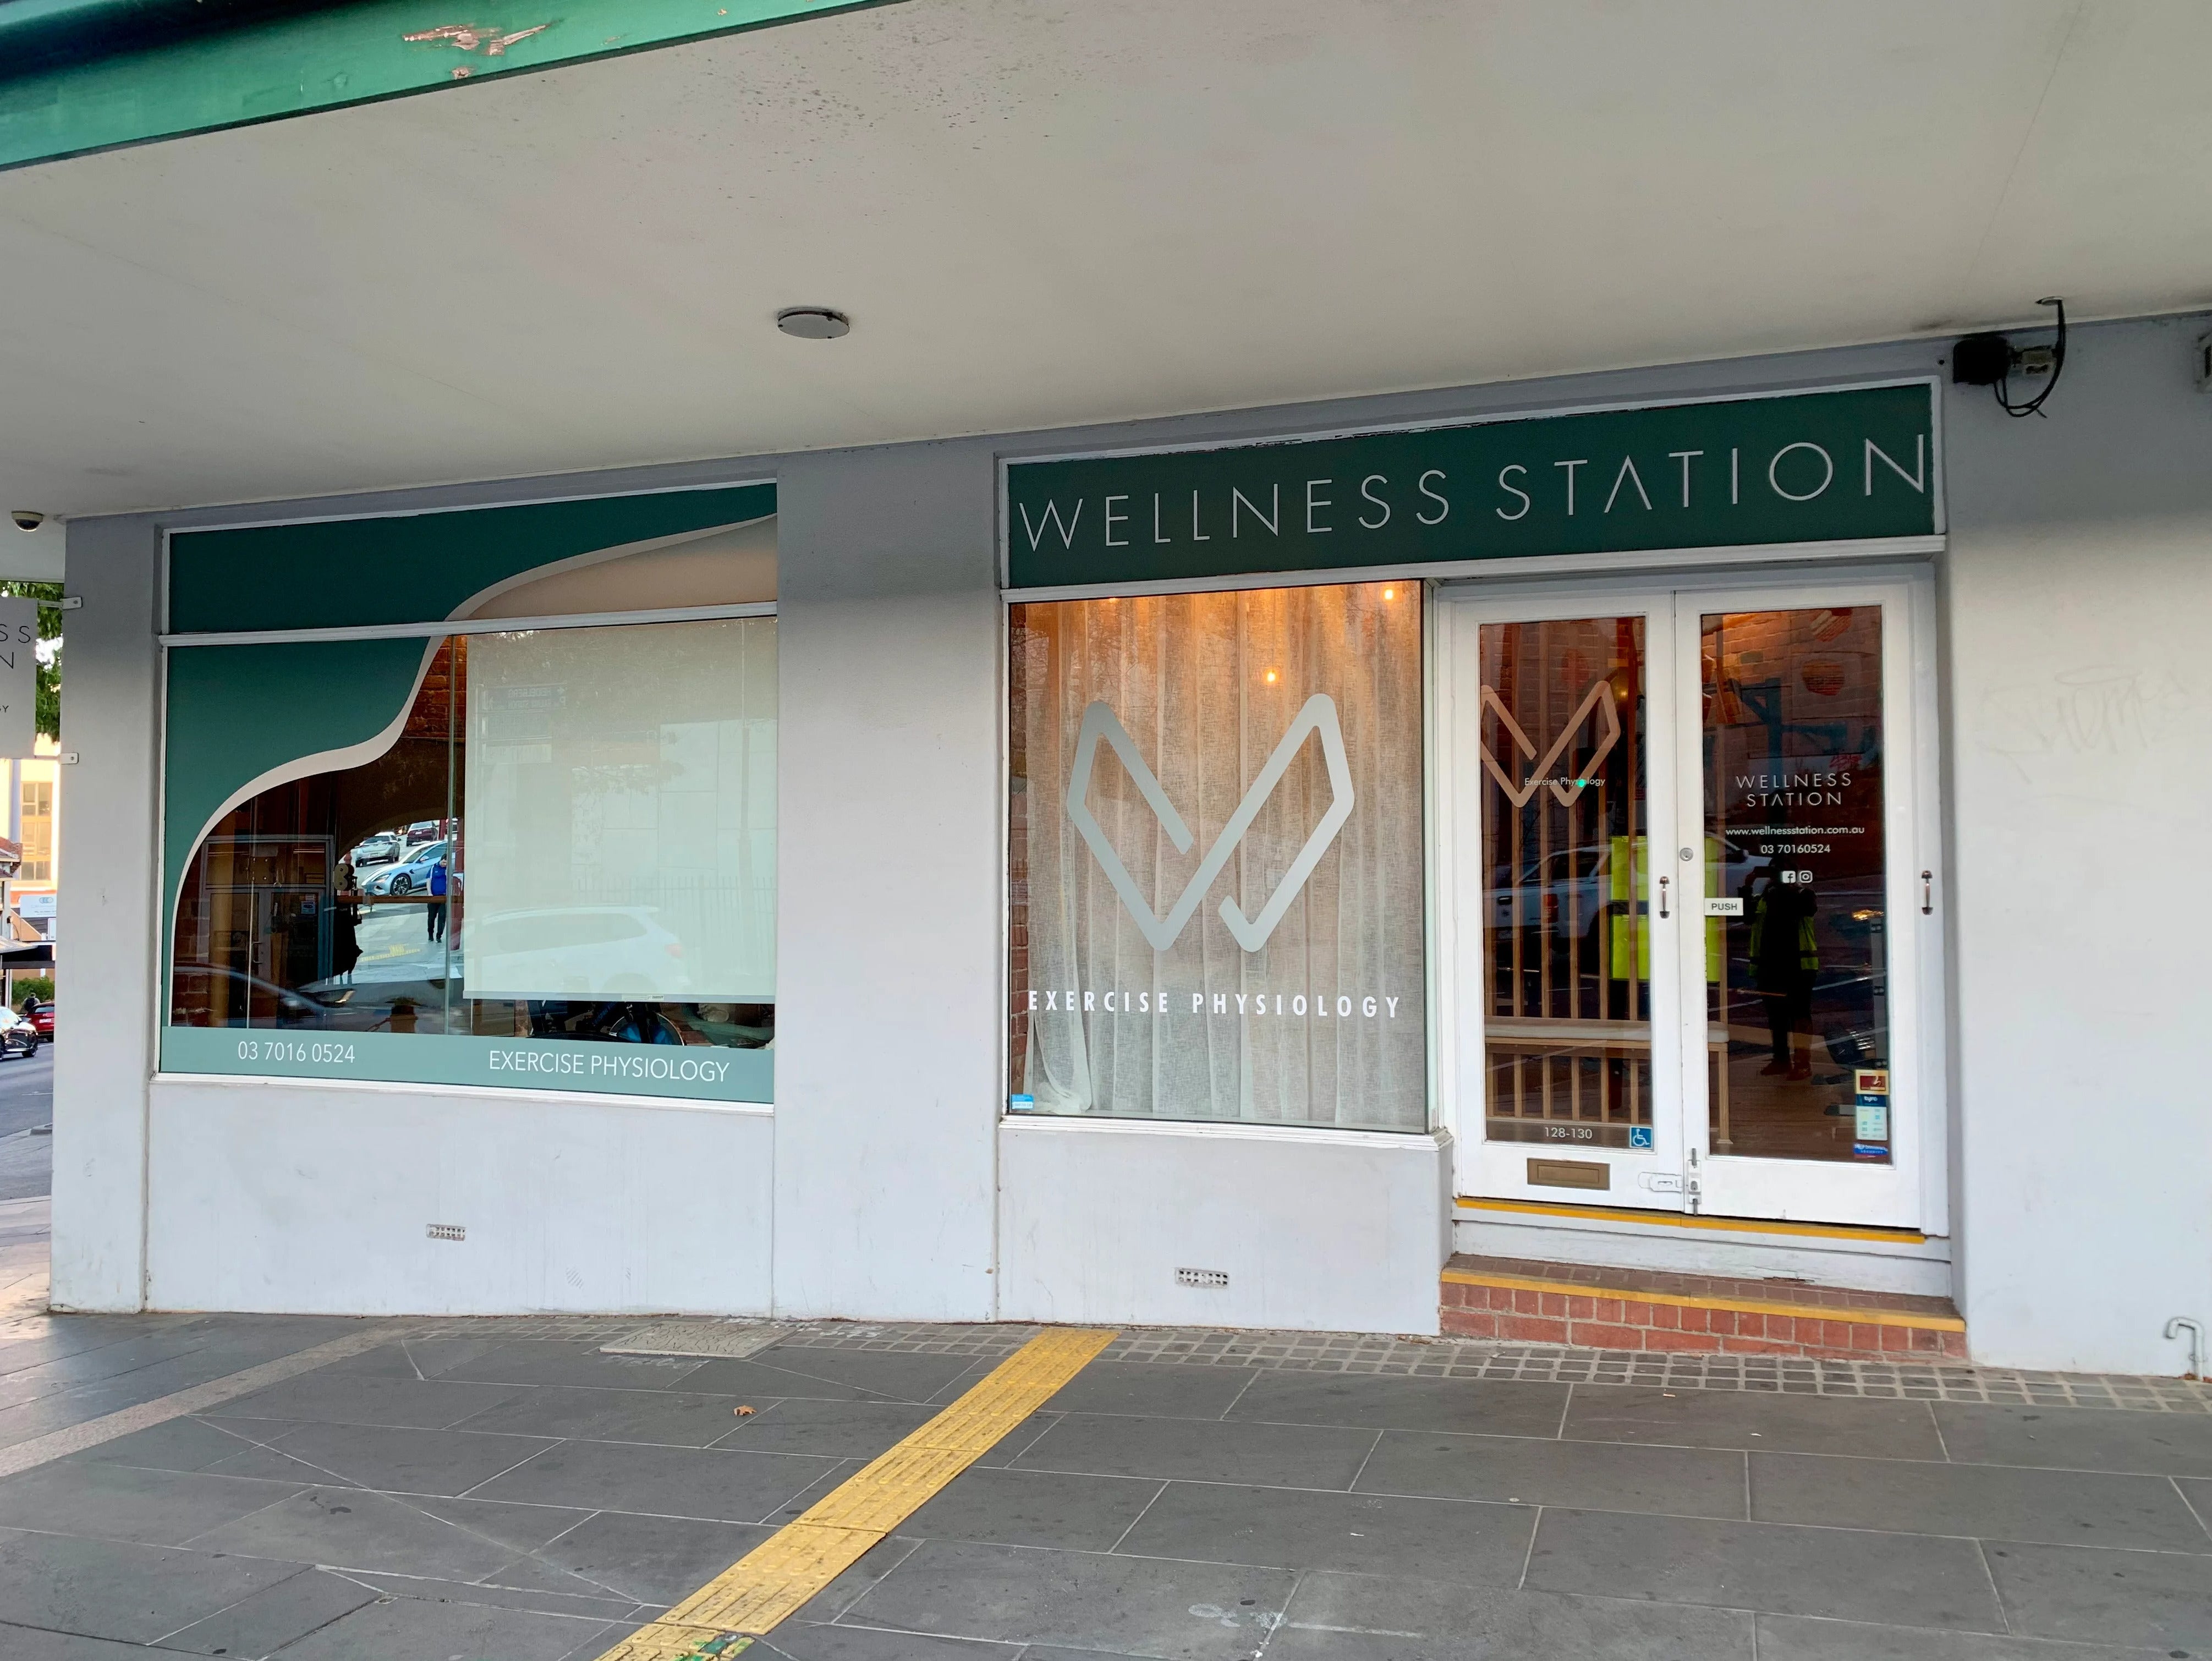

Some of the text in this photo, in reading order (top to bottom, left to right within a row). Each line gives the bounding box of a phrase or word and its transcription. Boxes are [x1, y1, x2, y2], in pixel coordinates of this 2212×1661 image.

[1019, 434, 1925, 551] WELLNESS STATION
[1524, 776, 1606, 787] Exercise Physlogy
[1736, 772, 1851, 788] WELLNESS
[1747, 792, 1841, 807] STATION
[1726, 825, 1865, 836] www.wellnessstation.com.au
[1760, 844, 1831, 854] 03 70160524
[1028, 990, 1399, 1018] EXERCISE PHYSIOLOGY
[237, 1041, 356, 1064] 03 7016 0524
[489, 1050, 730, 1082] EXERCISE PHYSIOLOGY
[1545, 1127, 1593, 1139] 128-130
